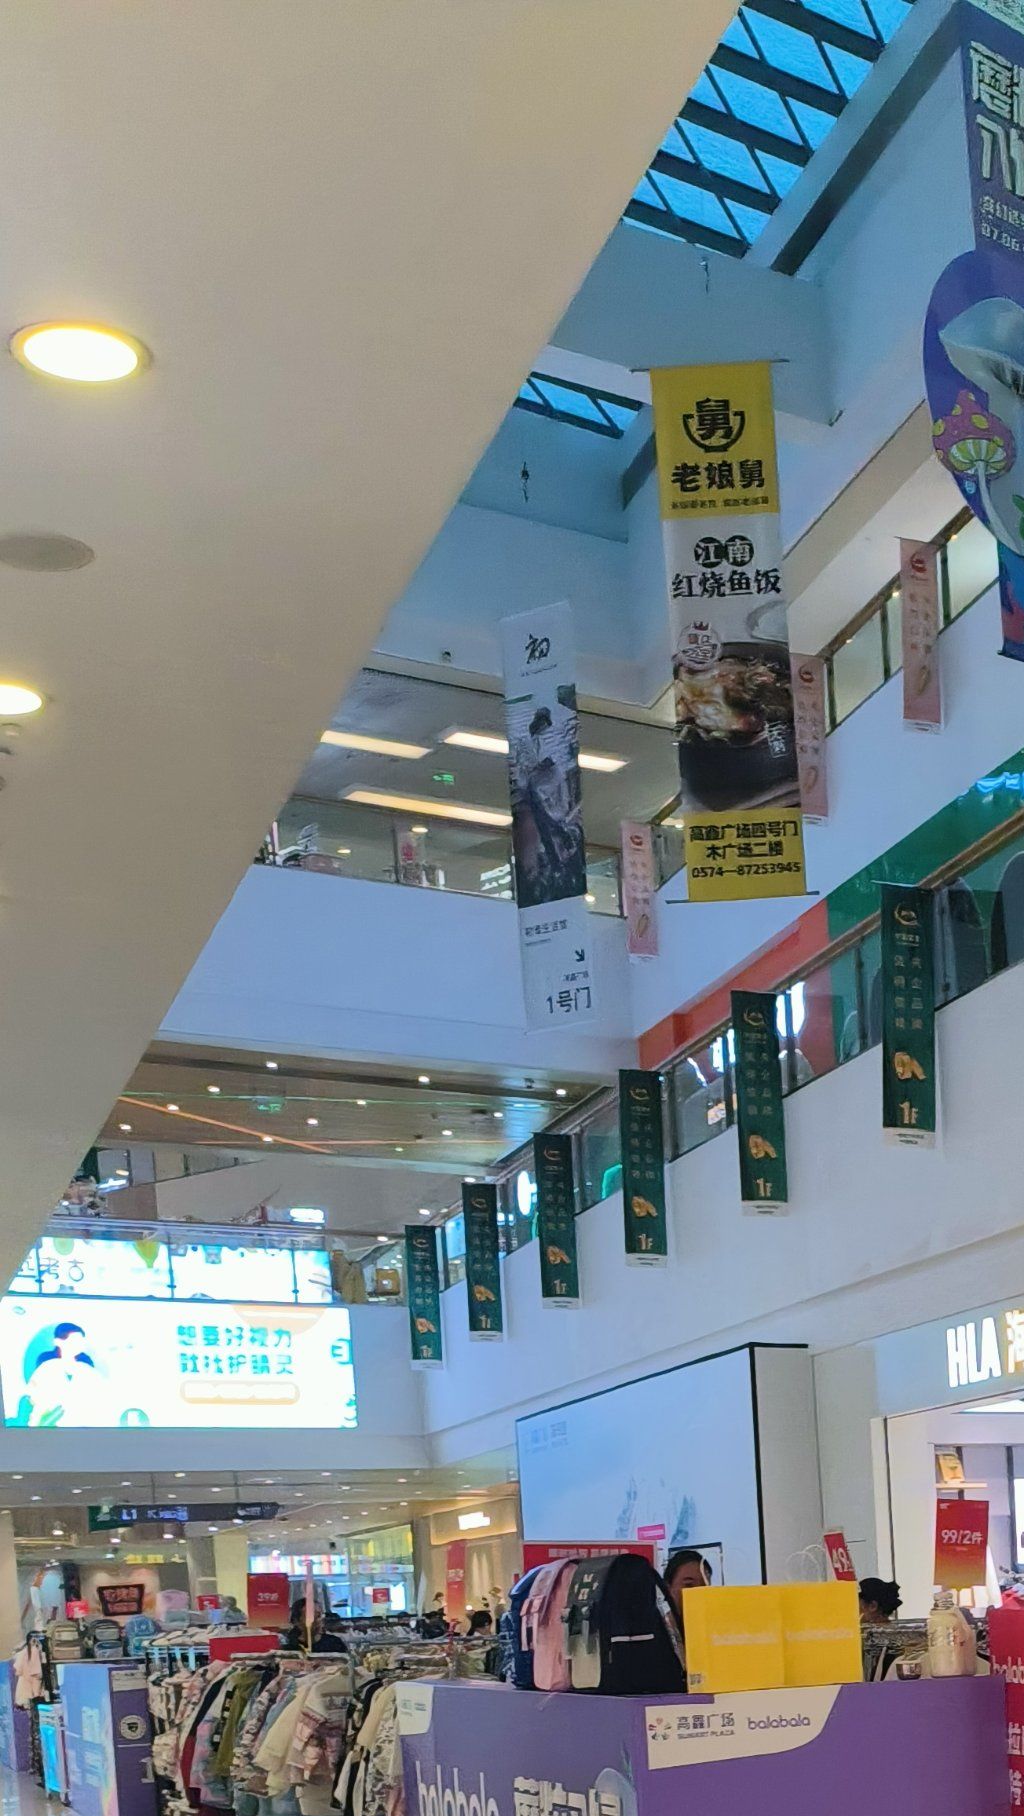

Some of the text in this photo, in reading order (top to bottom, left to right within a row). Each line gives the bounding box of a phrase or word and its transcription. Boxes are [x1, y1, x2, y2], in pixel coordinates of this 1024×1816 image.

[671, 459, 765, 492] 老娘舅
[695, 538, 752, 566] 江南
[672, 567, 782, 599] 红烧鱼饭
[689, 820, 799, 842] 高鑫广场四号门
[545, 986, 592, 1014] 1号门
[899, 1101, 919, 1124] 1F
[756, 1177, 773, 1198] 1F
[946, 1317, 1002, 1388] HLA
[941, 1529, 984, 1545] 99/2件
[747, 1713, 811, 1731] balabala
